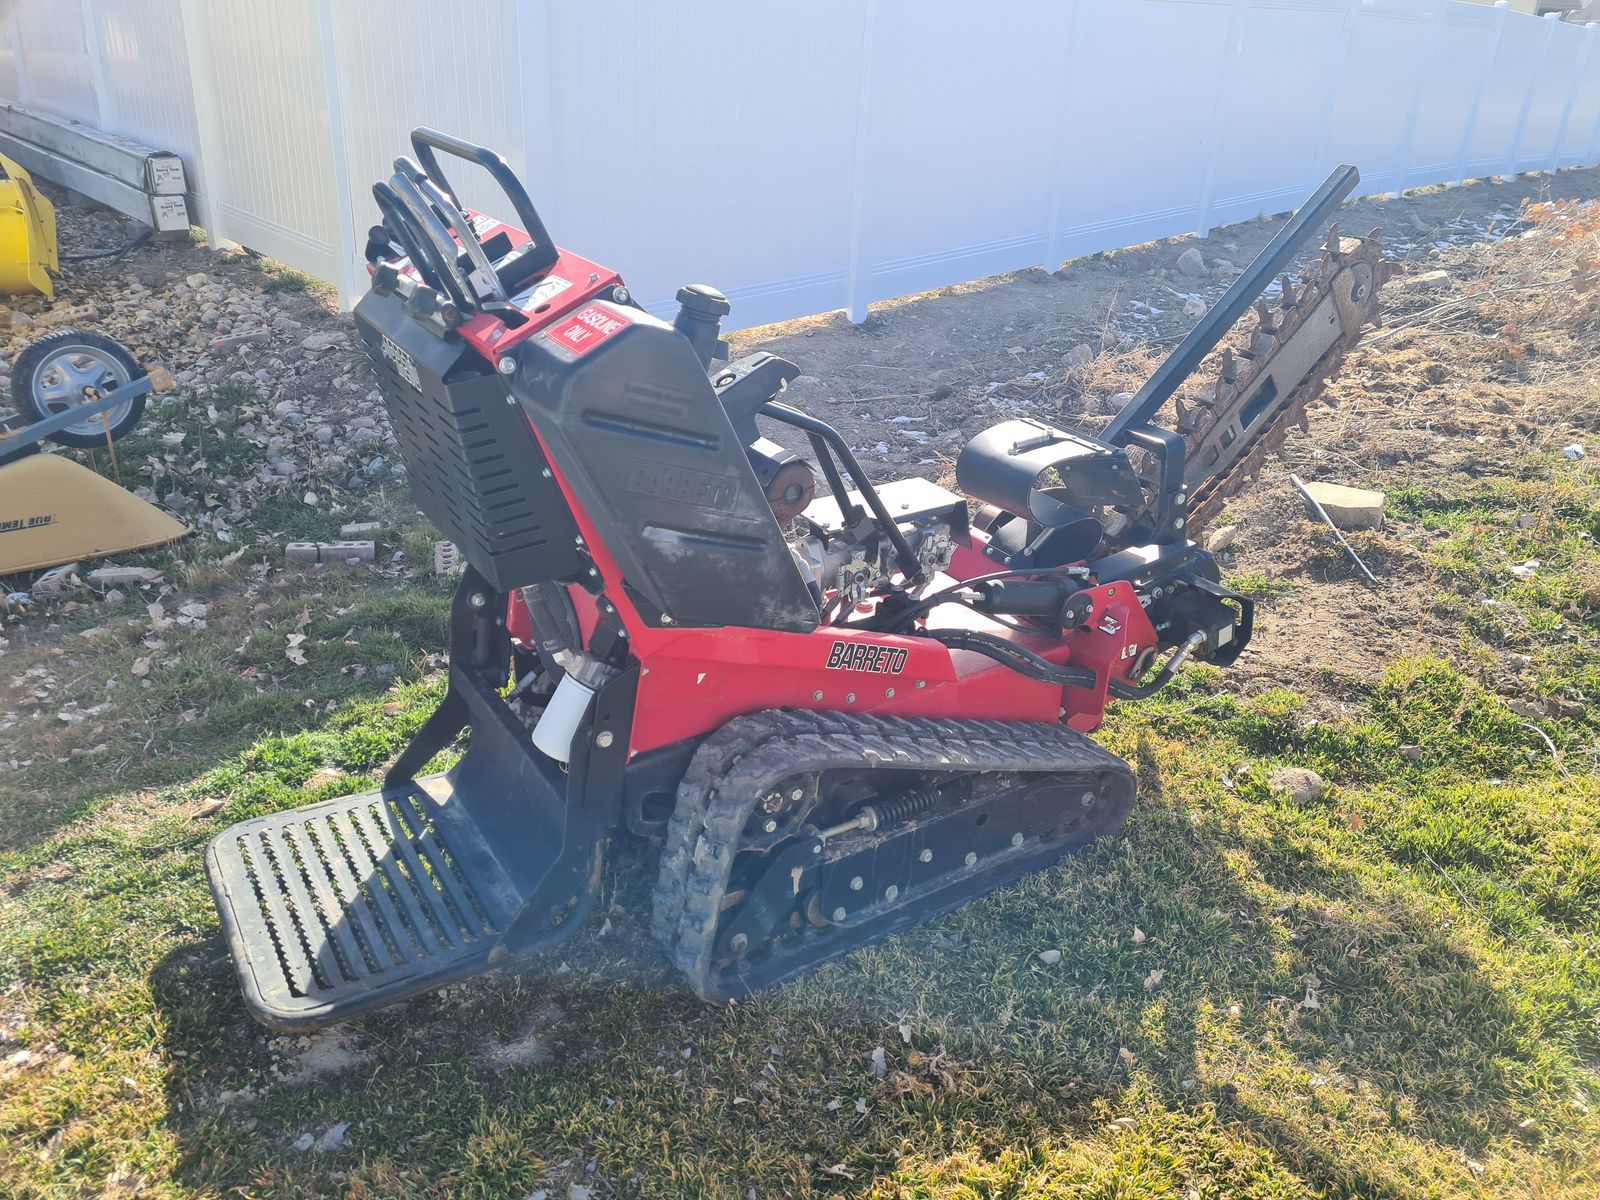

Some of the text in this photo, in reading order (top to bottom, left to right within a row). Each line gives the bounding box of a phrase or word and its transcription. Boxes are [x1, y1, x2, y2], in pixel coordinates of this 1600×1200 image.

[563, 324, 593, 343] ONLY
[576, 308, 623, 335] GASOLINE
[633, 465, 735, 510] BARRETO
[825, 640, 909, 675] BARRETO
